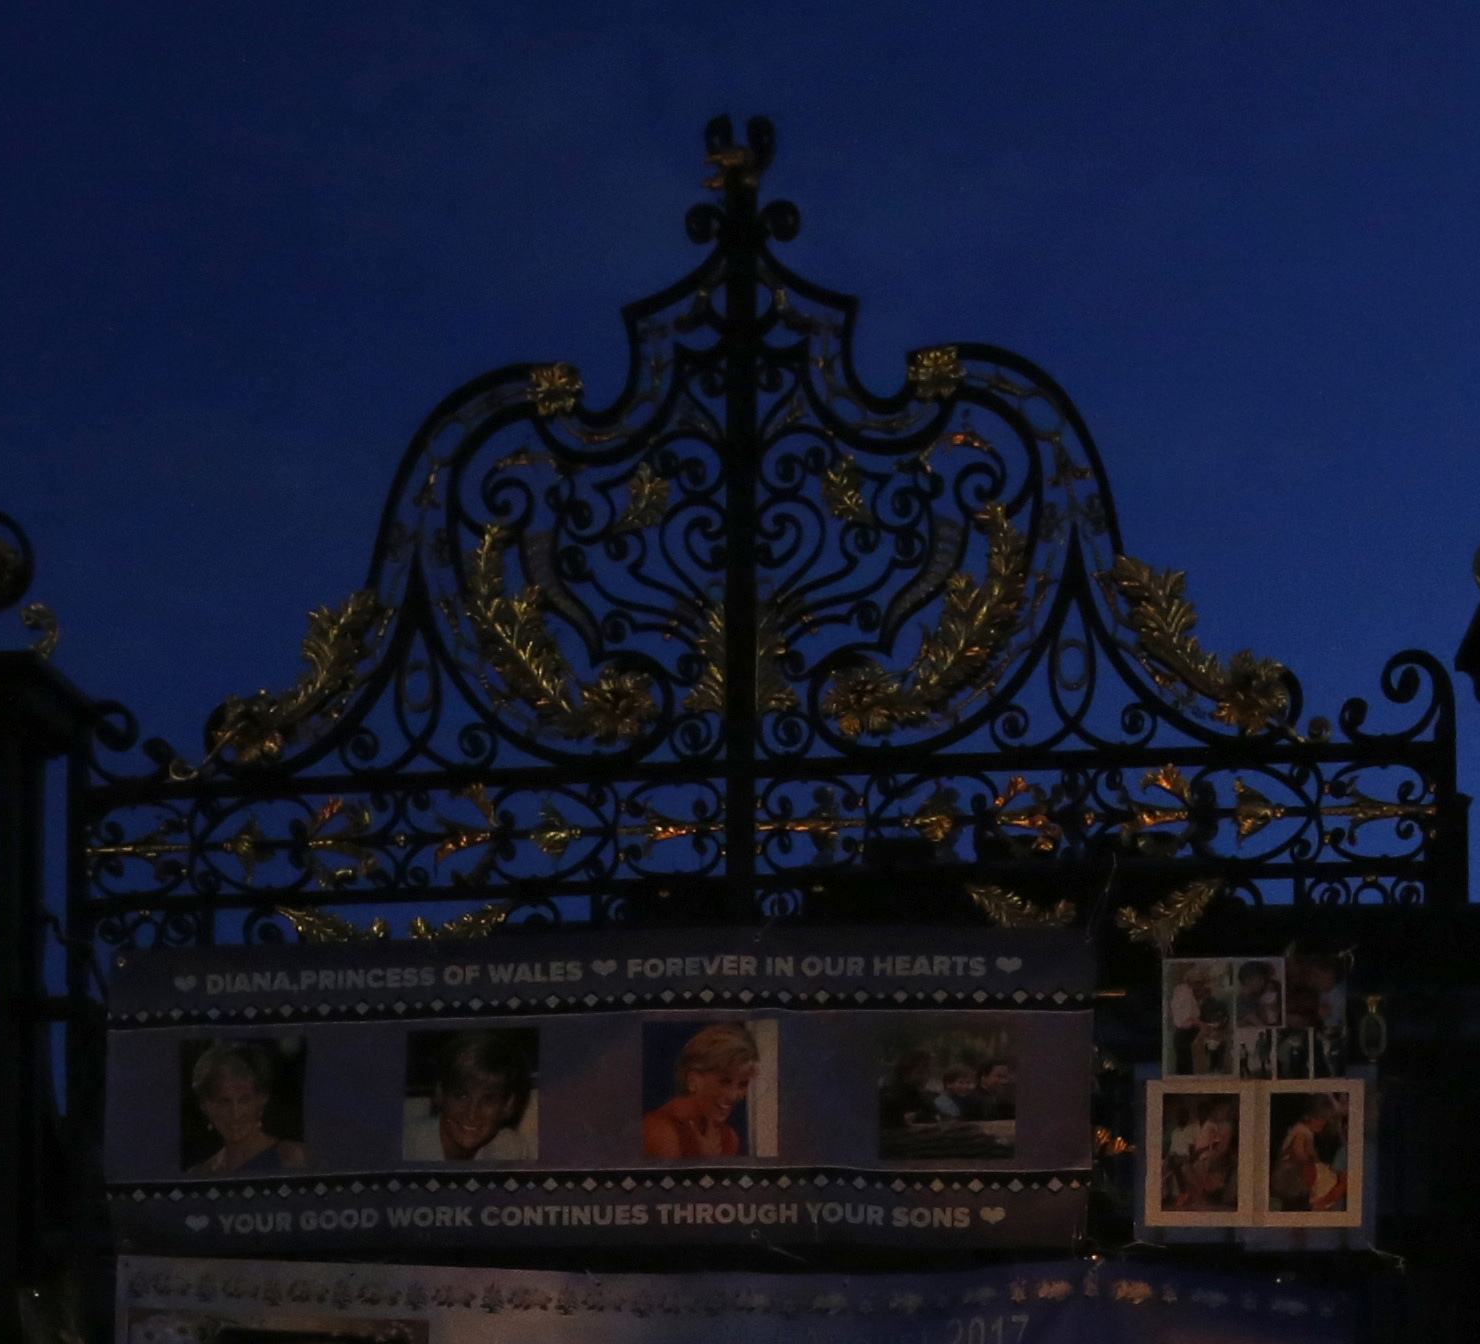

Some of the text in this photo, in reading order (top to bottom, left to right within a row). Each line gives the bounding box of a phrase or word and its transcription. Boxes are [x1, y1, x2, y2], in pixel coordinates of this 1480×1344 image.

[442, 964, 481, 986] OF
[487, 961, 583, 984] WALES
[626, 955, 757, 979] FOREVER
[765, 955, 794, 978] IN
[800, 956, 865, 978] OUR
[872, 955, 987, 978] HEARTS
[219, 1202, 971, 1234] YOUR GOOD WORK CONTINUES THROUGH YOUR SONS
